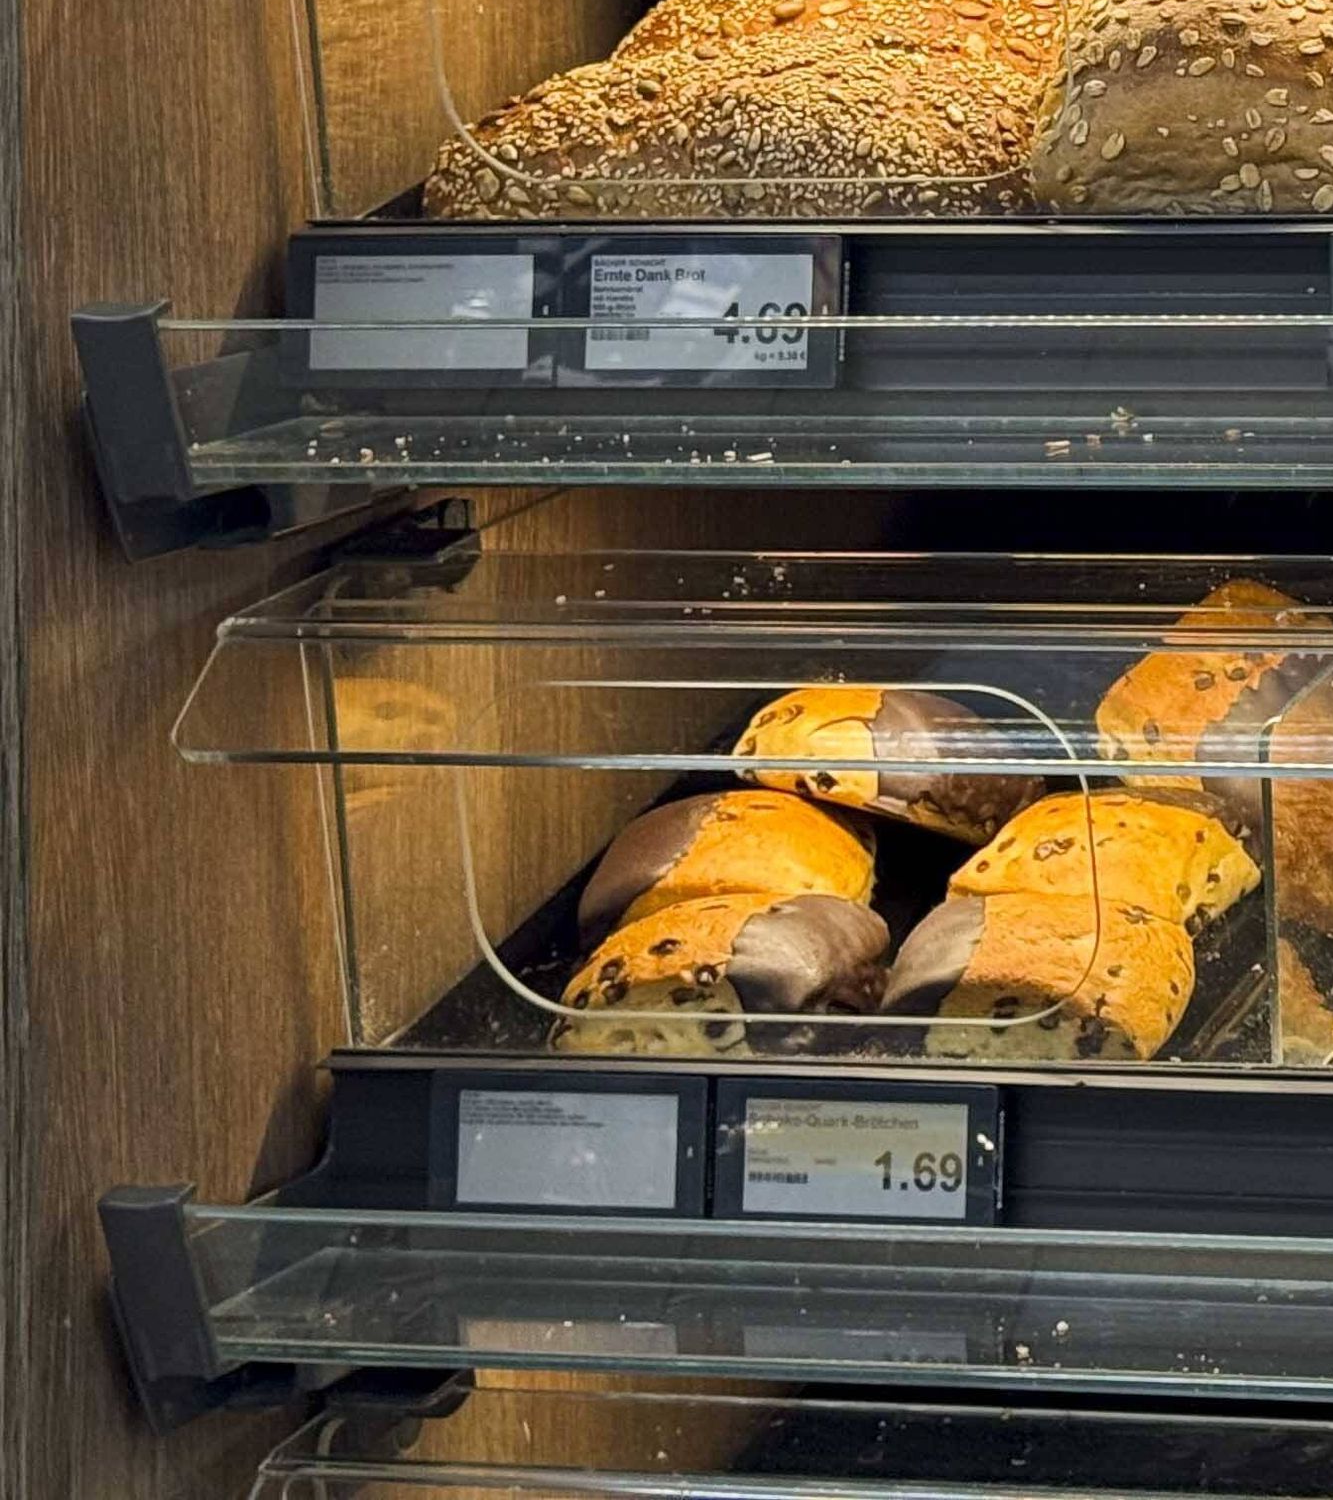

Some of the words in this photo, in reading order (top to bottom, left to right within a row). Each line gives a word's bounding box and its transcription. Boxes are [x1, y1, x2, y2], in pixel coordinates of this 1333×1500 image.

[594, 269, 632, 282] Ernte
[636, 268, 670, 282] Dank
[714, 302, 807, 344] 4.69
[875, 1151, 963, 1192] 1.69
